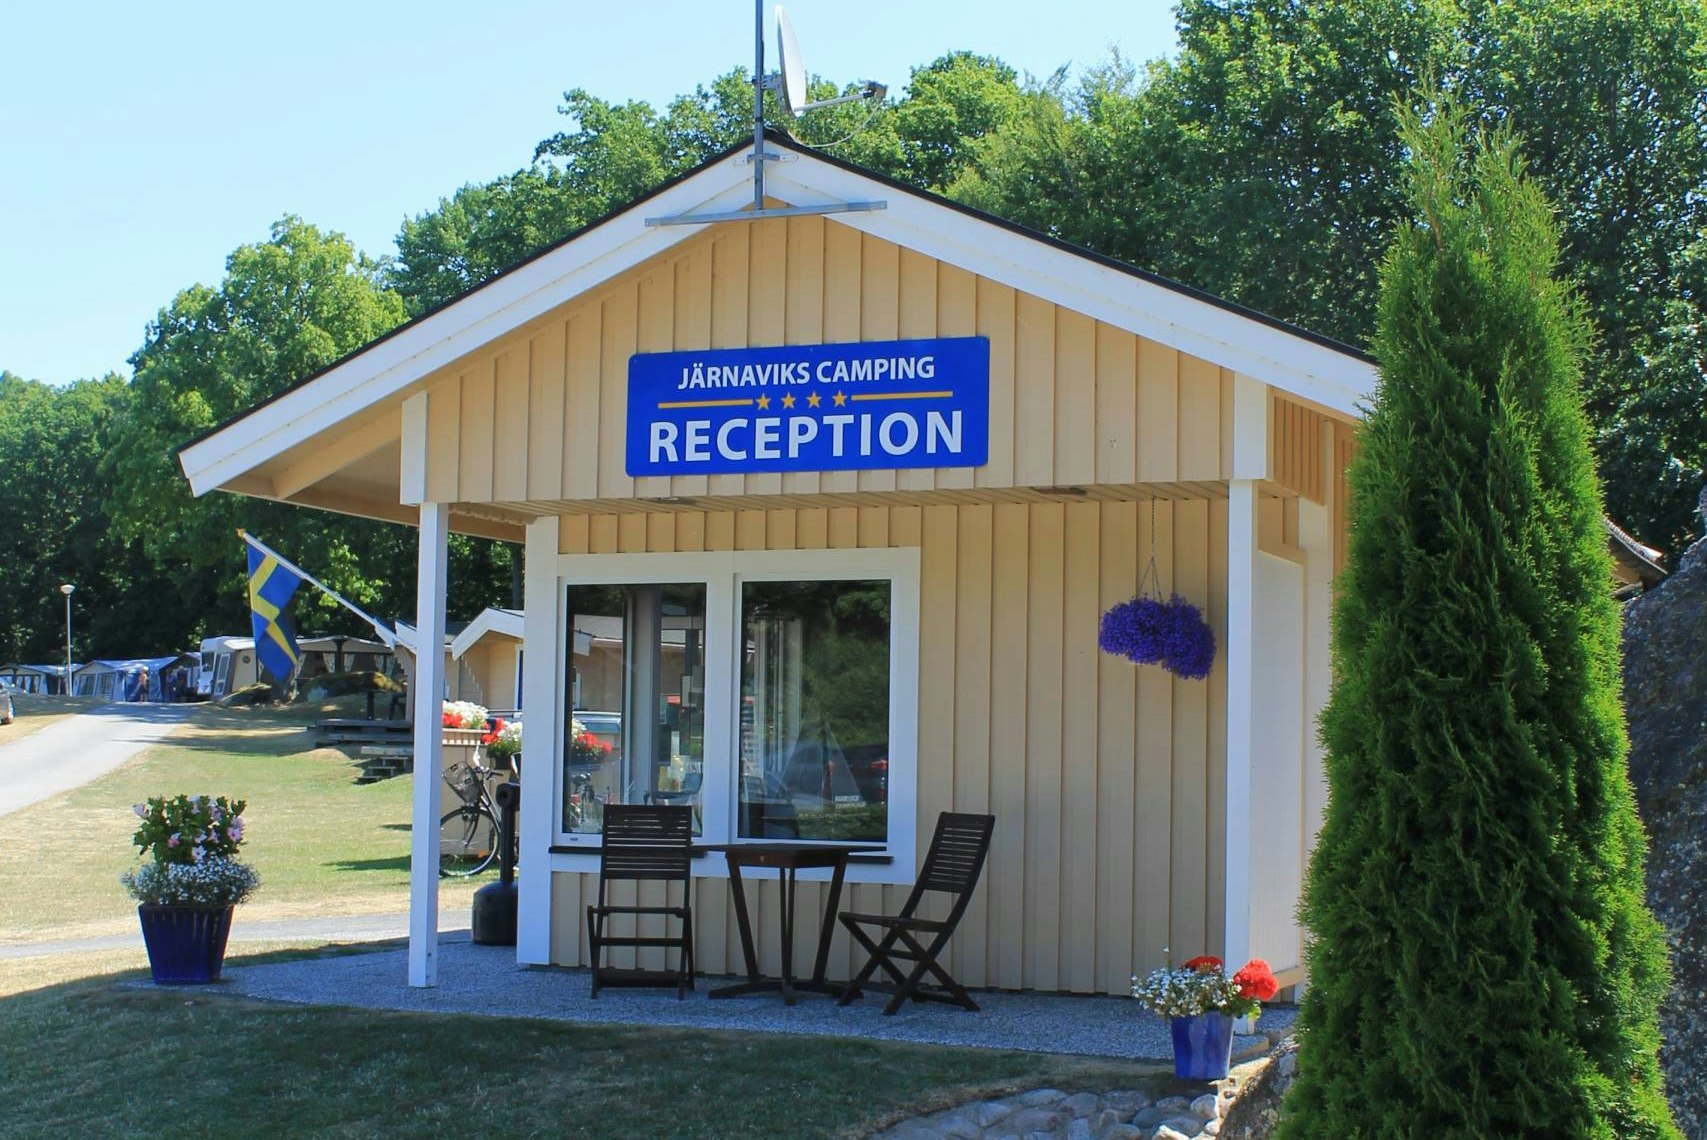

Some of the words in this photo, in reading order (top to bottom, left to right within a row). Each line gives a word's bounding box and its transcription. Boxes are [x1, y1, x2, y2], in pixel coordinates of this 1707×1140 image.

[677, 361, 810, 390] JÄRNAVIKS
[816, 356, 935, 383] CAMPING
[649, 410, 963, 463] RECEPTION
